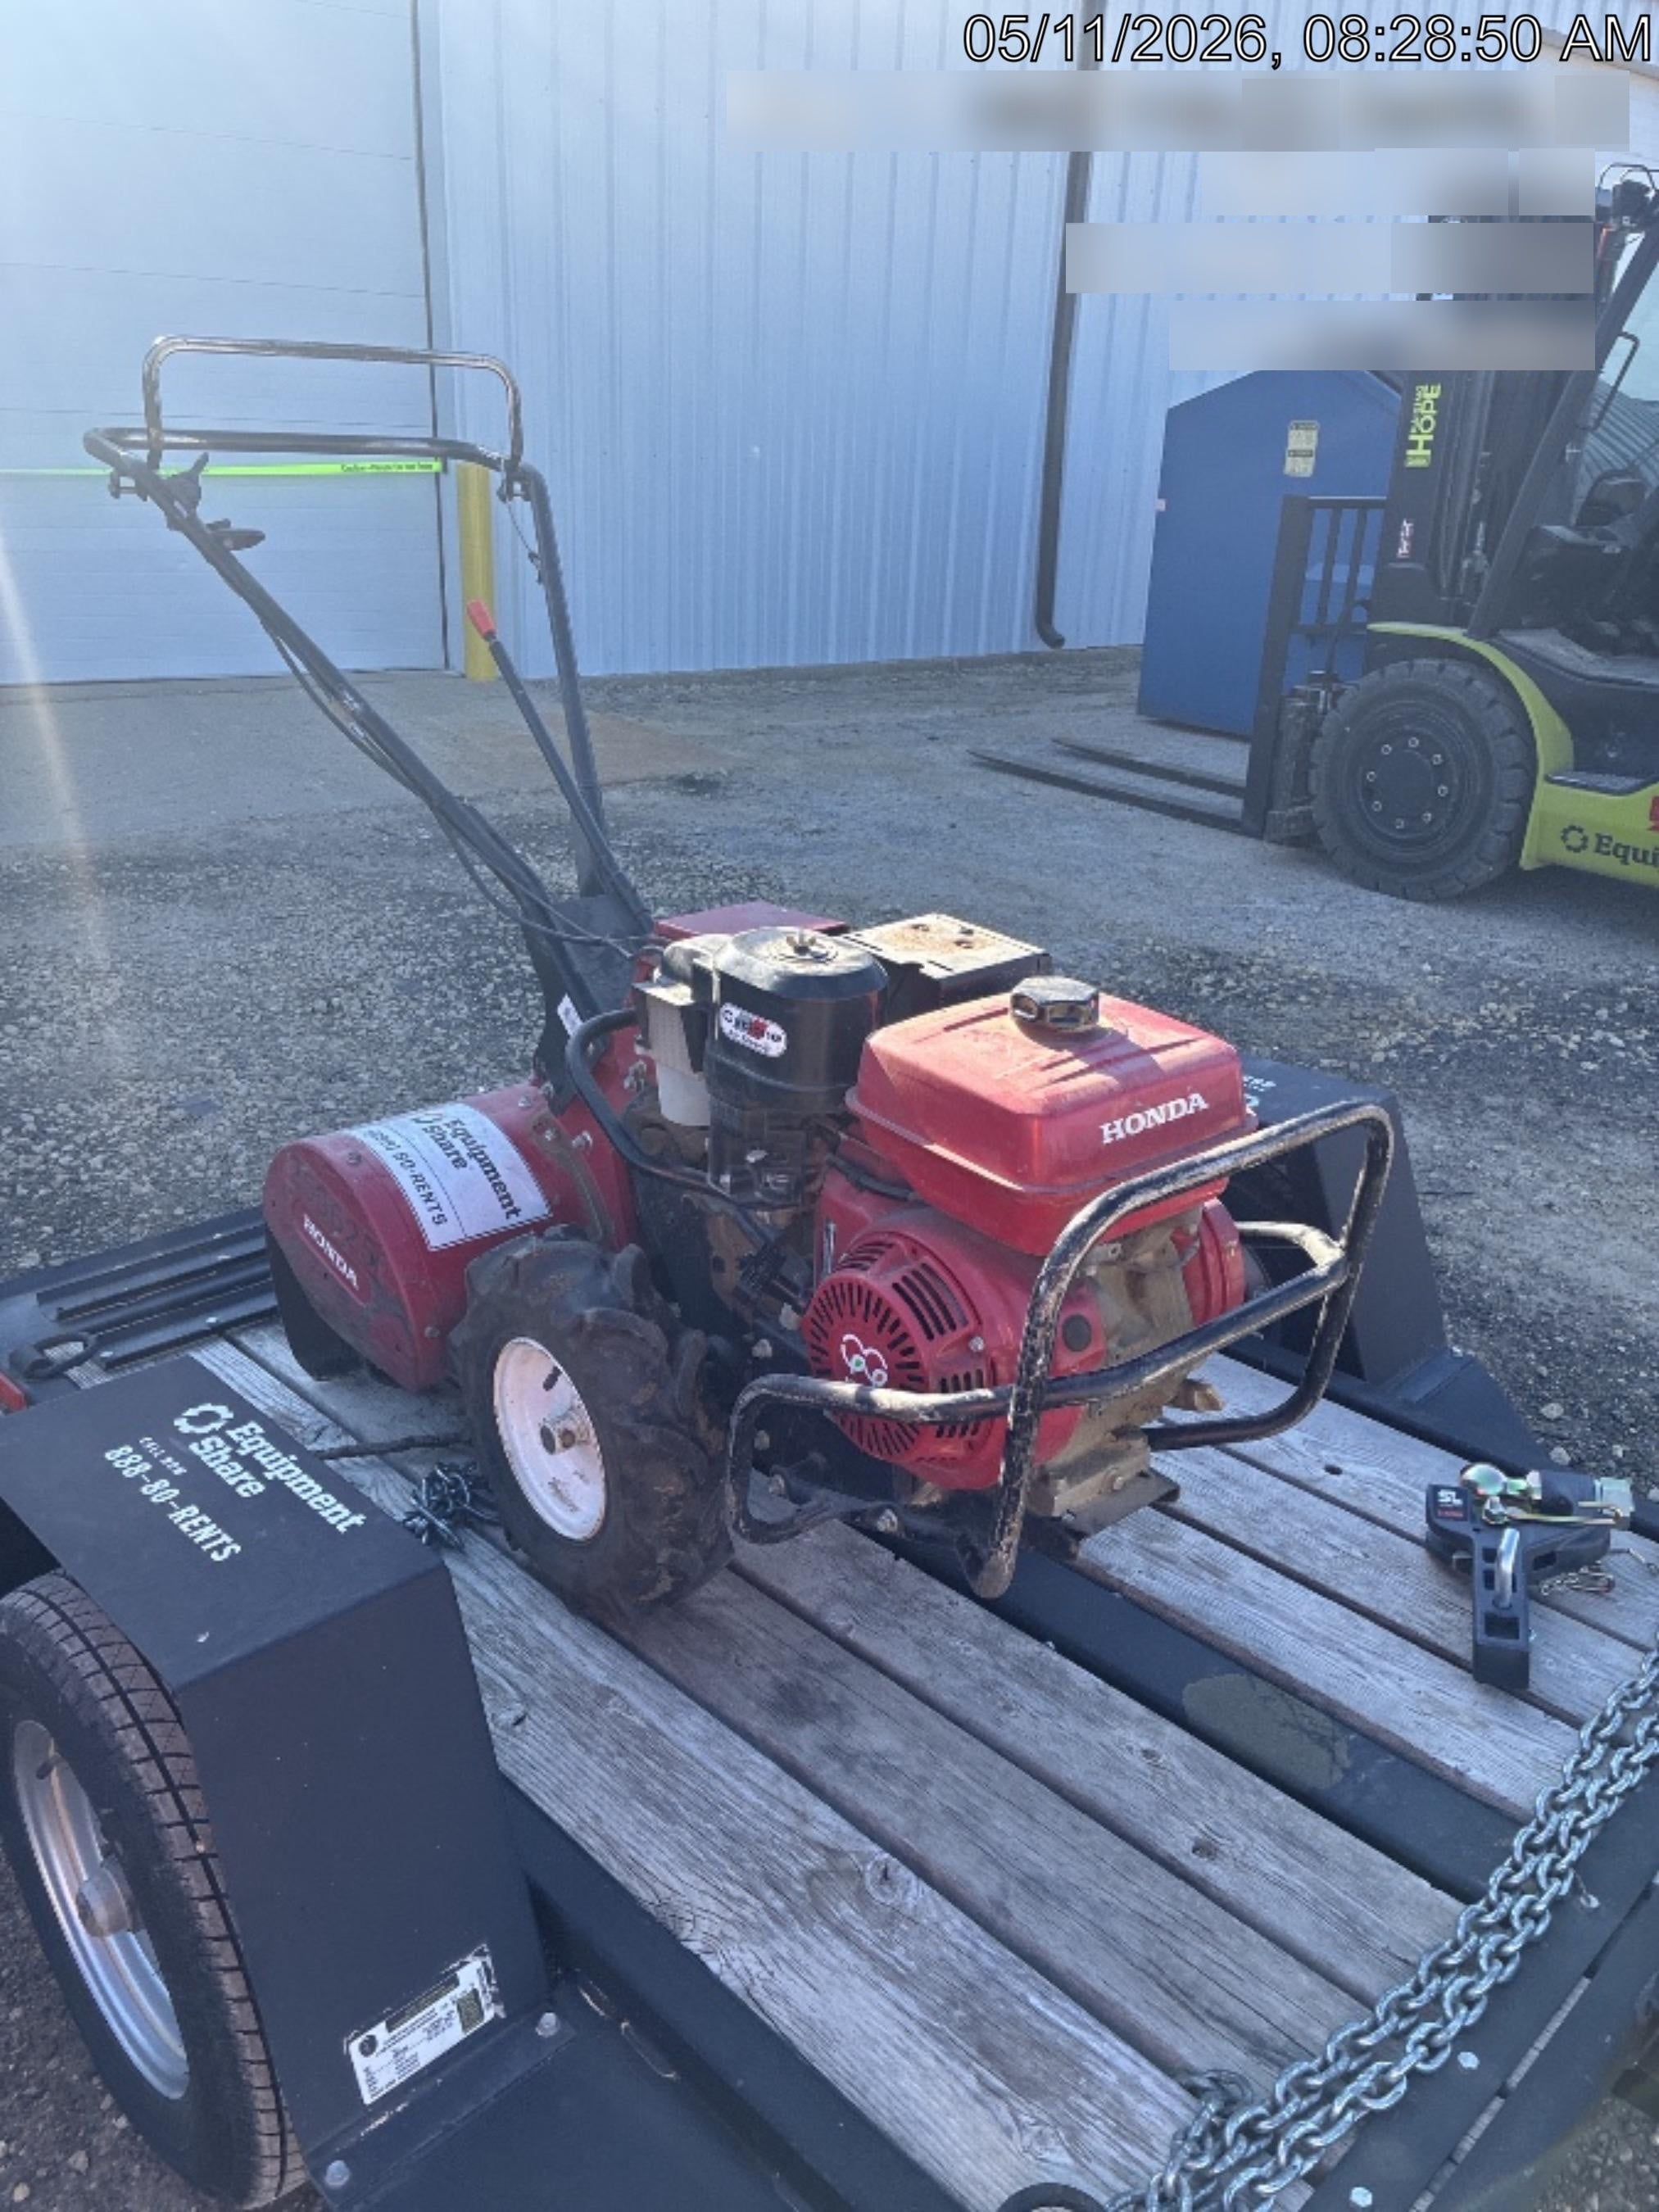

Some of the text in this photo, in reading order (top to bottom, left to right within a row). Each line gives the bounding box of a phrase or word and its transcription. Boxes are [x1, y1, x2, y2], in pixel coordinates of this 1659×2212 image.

[1406, 383, 1442, 456] HOPE
[422, 1125, 468, 1170] Share
[1099, 1092, 1210, 1145] HONDA
[443, 1117, 522, 1220] Equipment
[303, 1213, 360, 1290] HONDA
[104, 1444, 242, 1562] 888-80-RENTS
[188, 1435, 266, 1498] Share
[225, 1421, 367, 1534] Equipment
